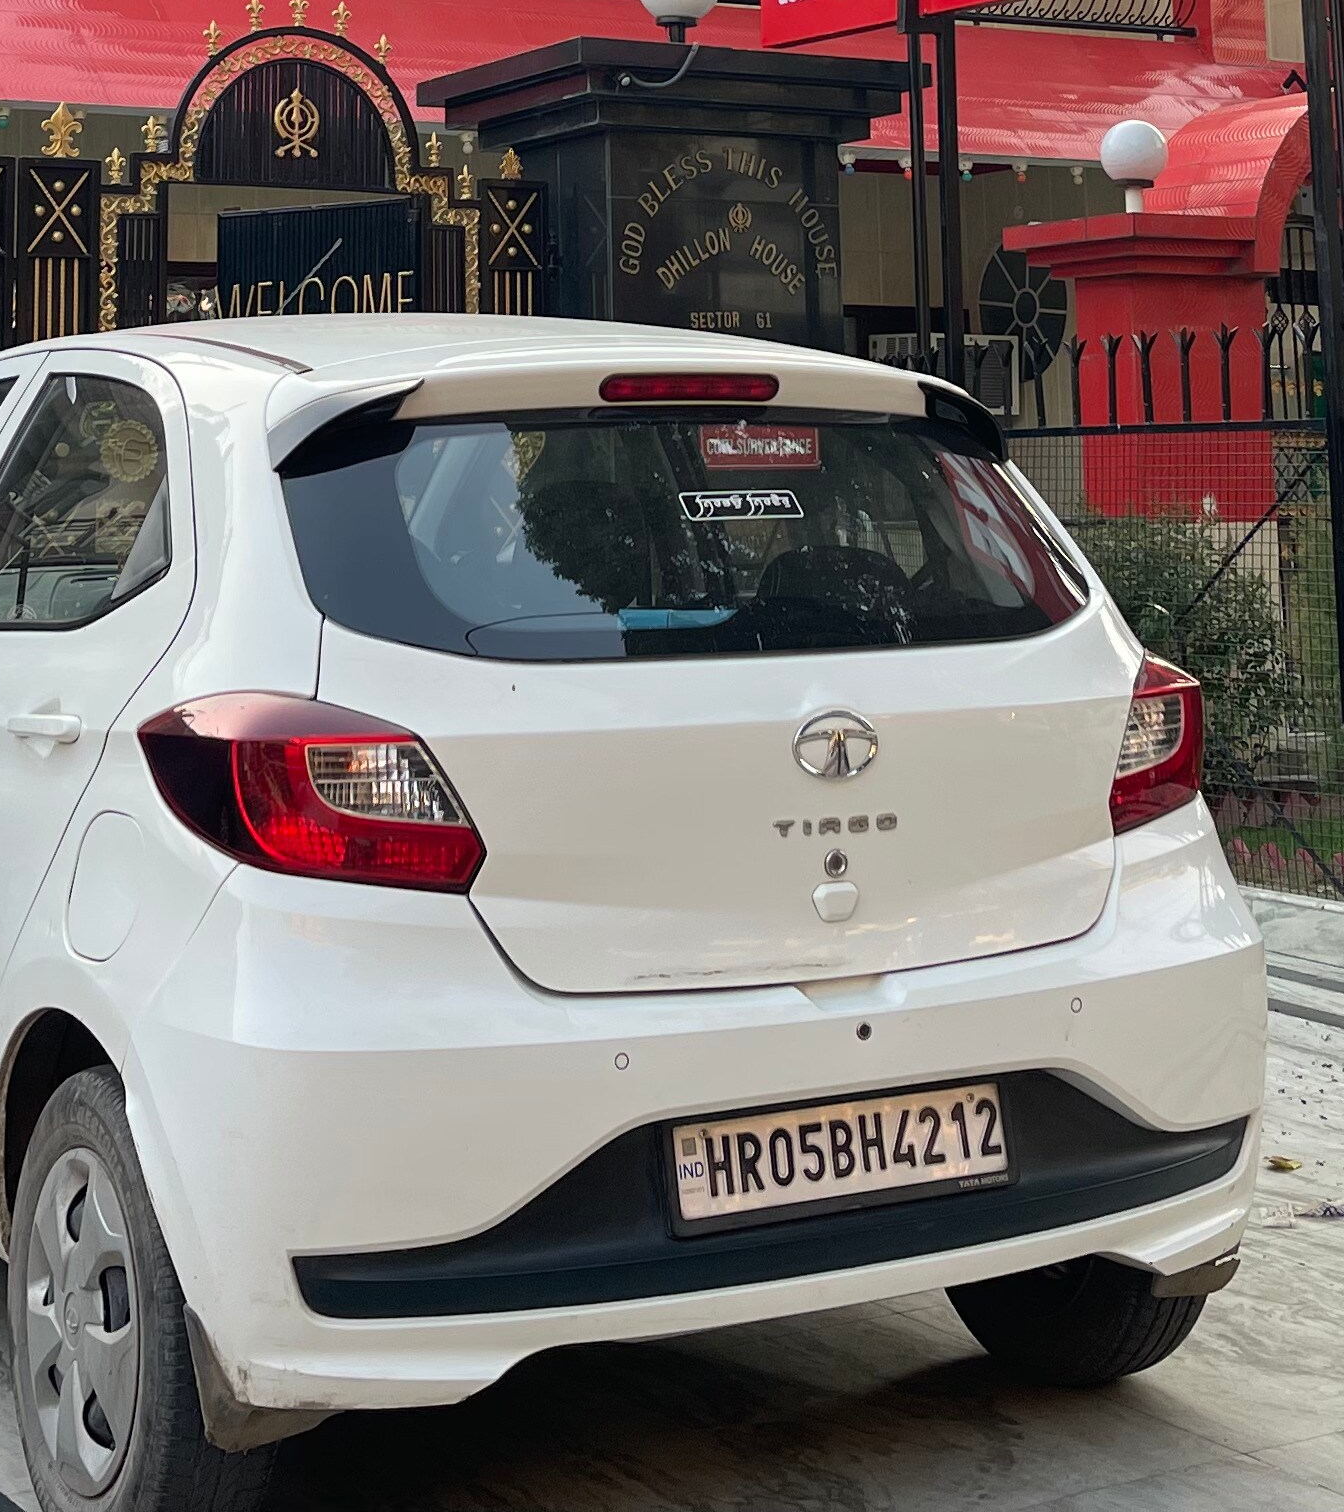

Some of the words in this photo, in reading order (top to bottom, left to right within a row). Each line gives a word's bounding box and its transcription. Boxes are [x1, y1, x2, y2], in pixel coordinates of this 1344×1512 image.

[619, 221, 646, 275] GOD
[637, 149, 712, 218] BLESS
[722, 147, 783, 189] THIS
[788, 188, 837, 279] HOUSE
[656, 227, 731, 290] DHILLON
[750, 235, 805, 295] HOUSE
[690, 311, 740, 330] SECTOR
[756, 311, 772, 329] 61
[678, 1161, 704, 1180] IND
[704, 1098, 1002, 1198] HR05BH4212
